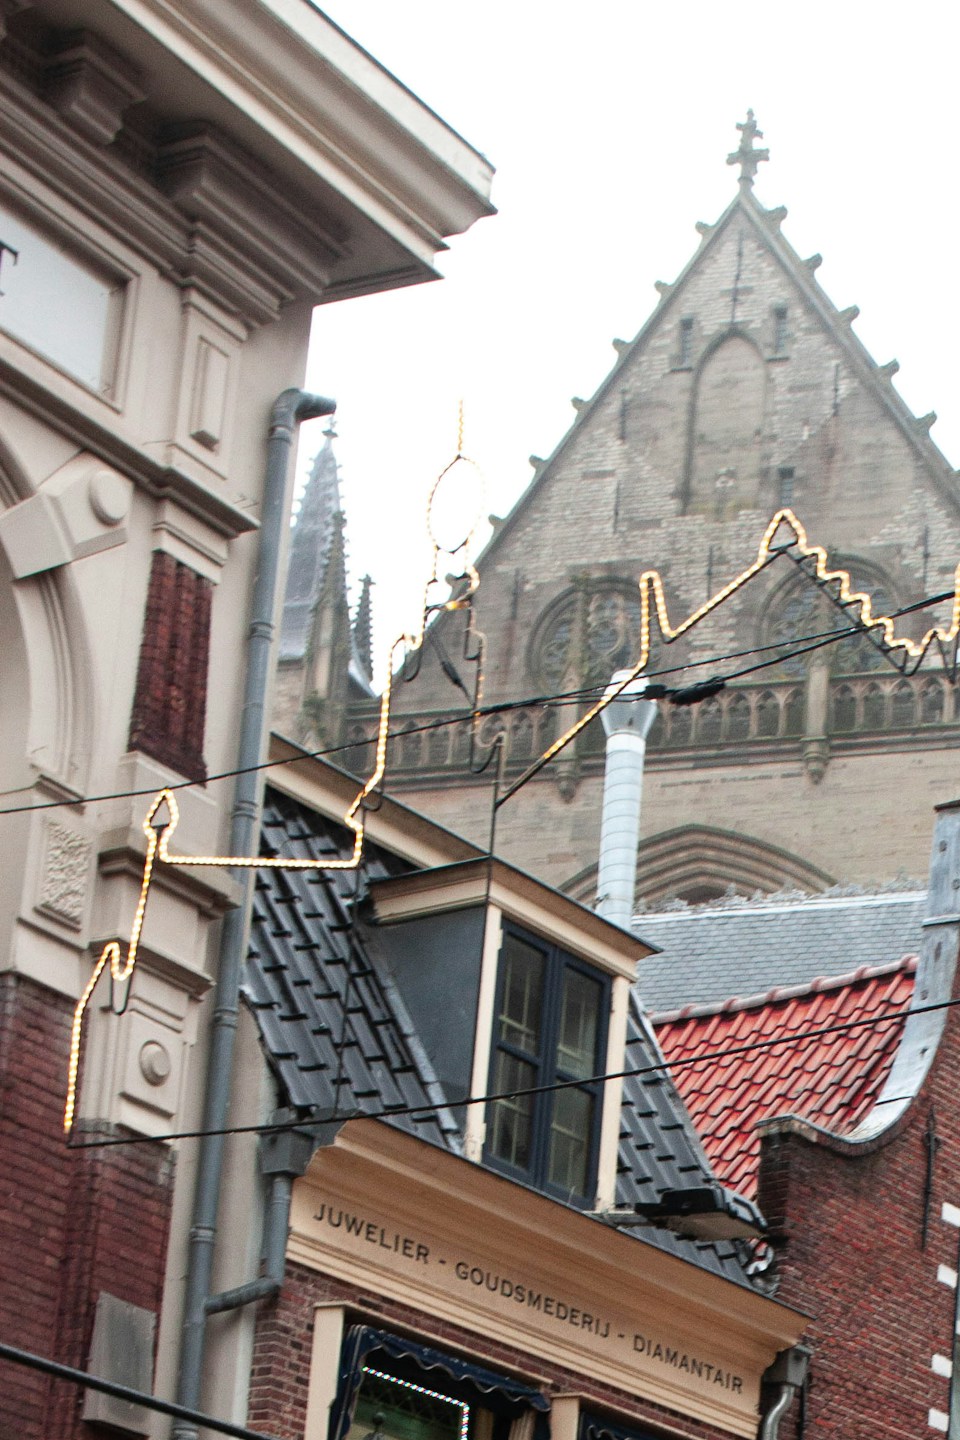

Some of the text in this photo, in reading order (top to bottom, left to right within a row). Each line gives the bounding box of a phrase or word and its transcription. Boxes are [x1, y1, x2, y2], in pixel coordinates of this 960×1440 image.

[313, 1203, 430, 1264] JUWELIER
[455, 1261, 611, 1339] GOUDSMEDERIJ
[632, 1334, 743, 1395] DIAMANTAIR
